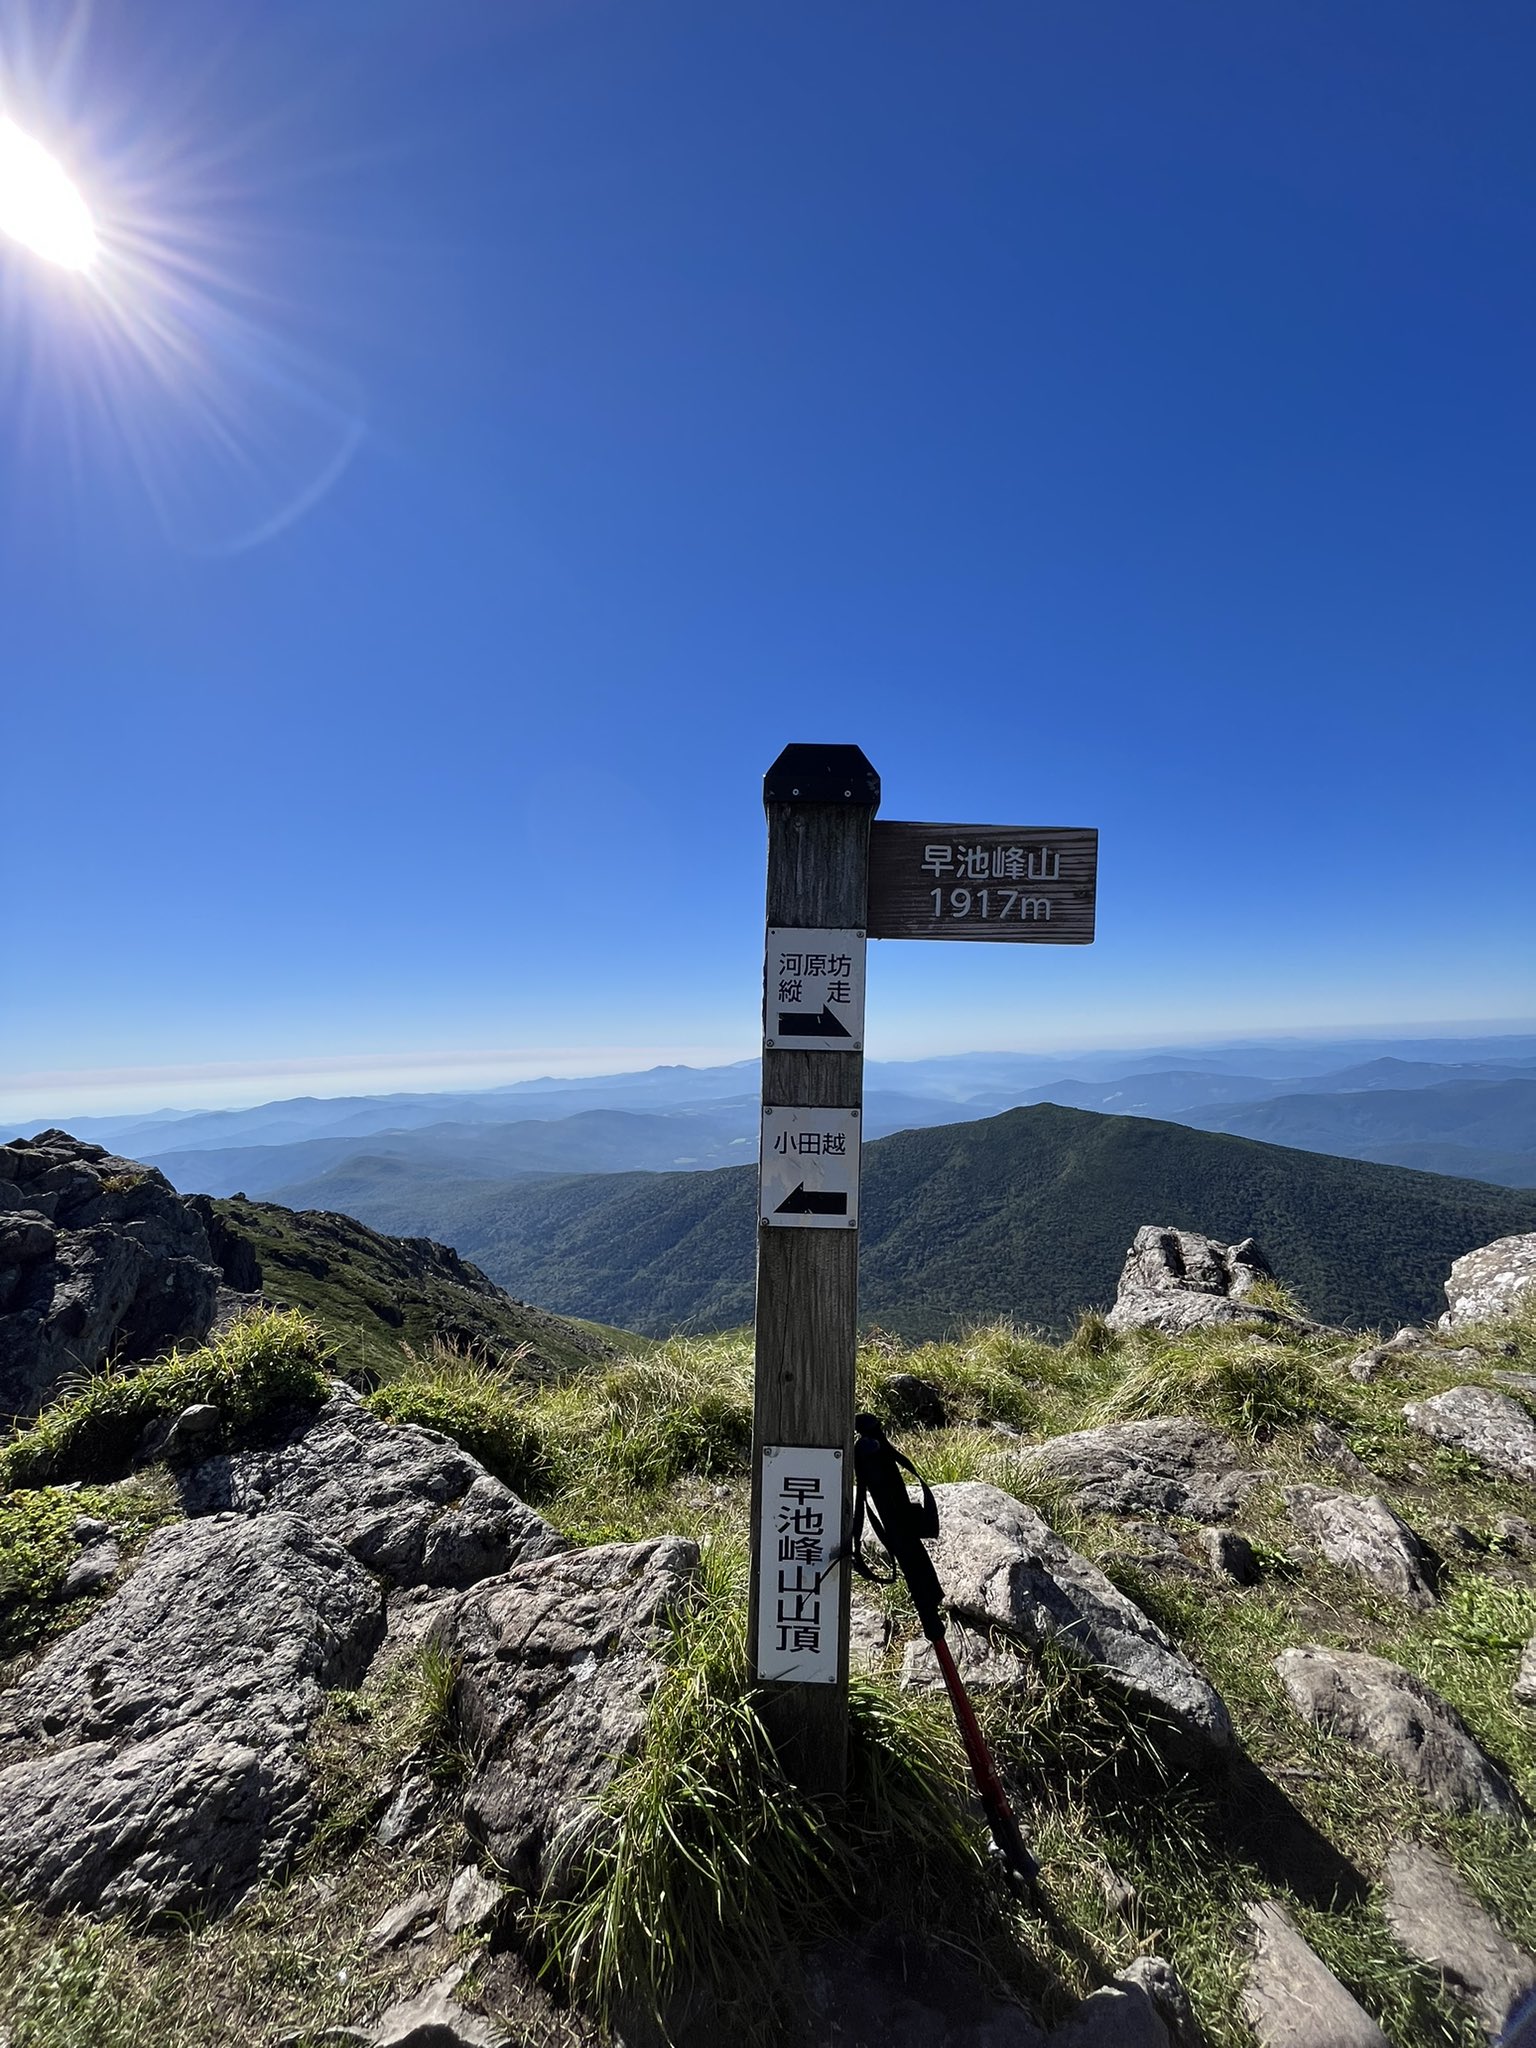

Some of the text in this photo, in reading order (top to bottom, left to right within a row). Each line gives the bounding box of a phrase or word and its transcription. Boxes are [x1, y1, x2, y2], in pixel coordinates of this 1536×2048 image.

[921, 845, 1060, 881] 早池峰山
[929, 888, 1051, 921] 1917m
[779, 952, 852, 977] 河原坊
[774, 1131, 846, 1155] 小田越
[775, 1477, 825, 1654] 早池峰山山頂
